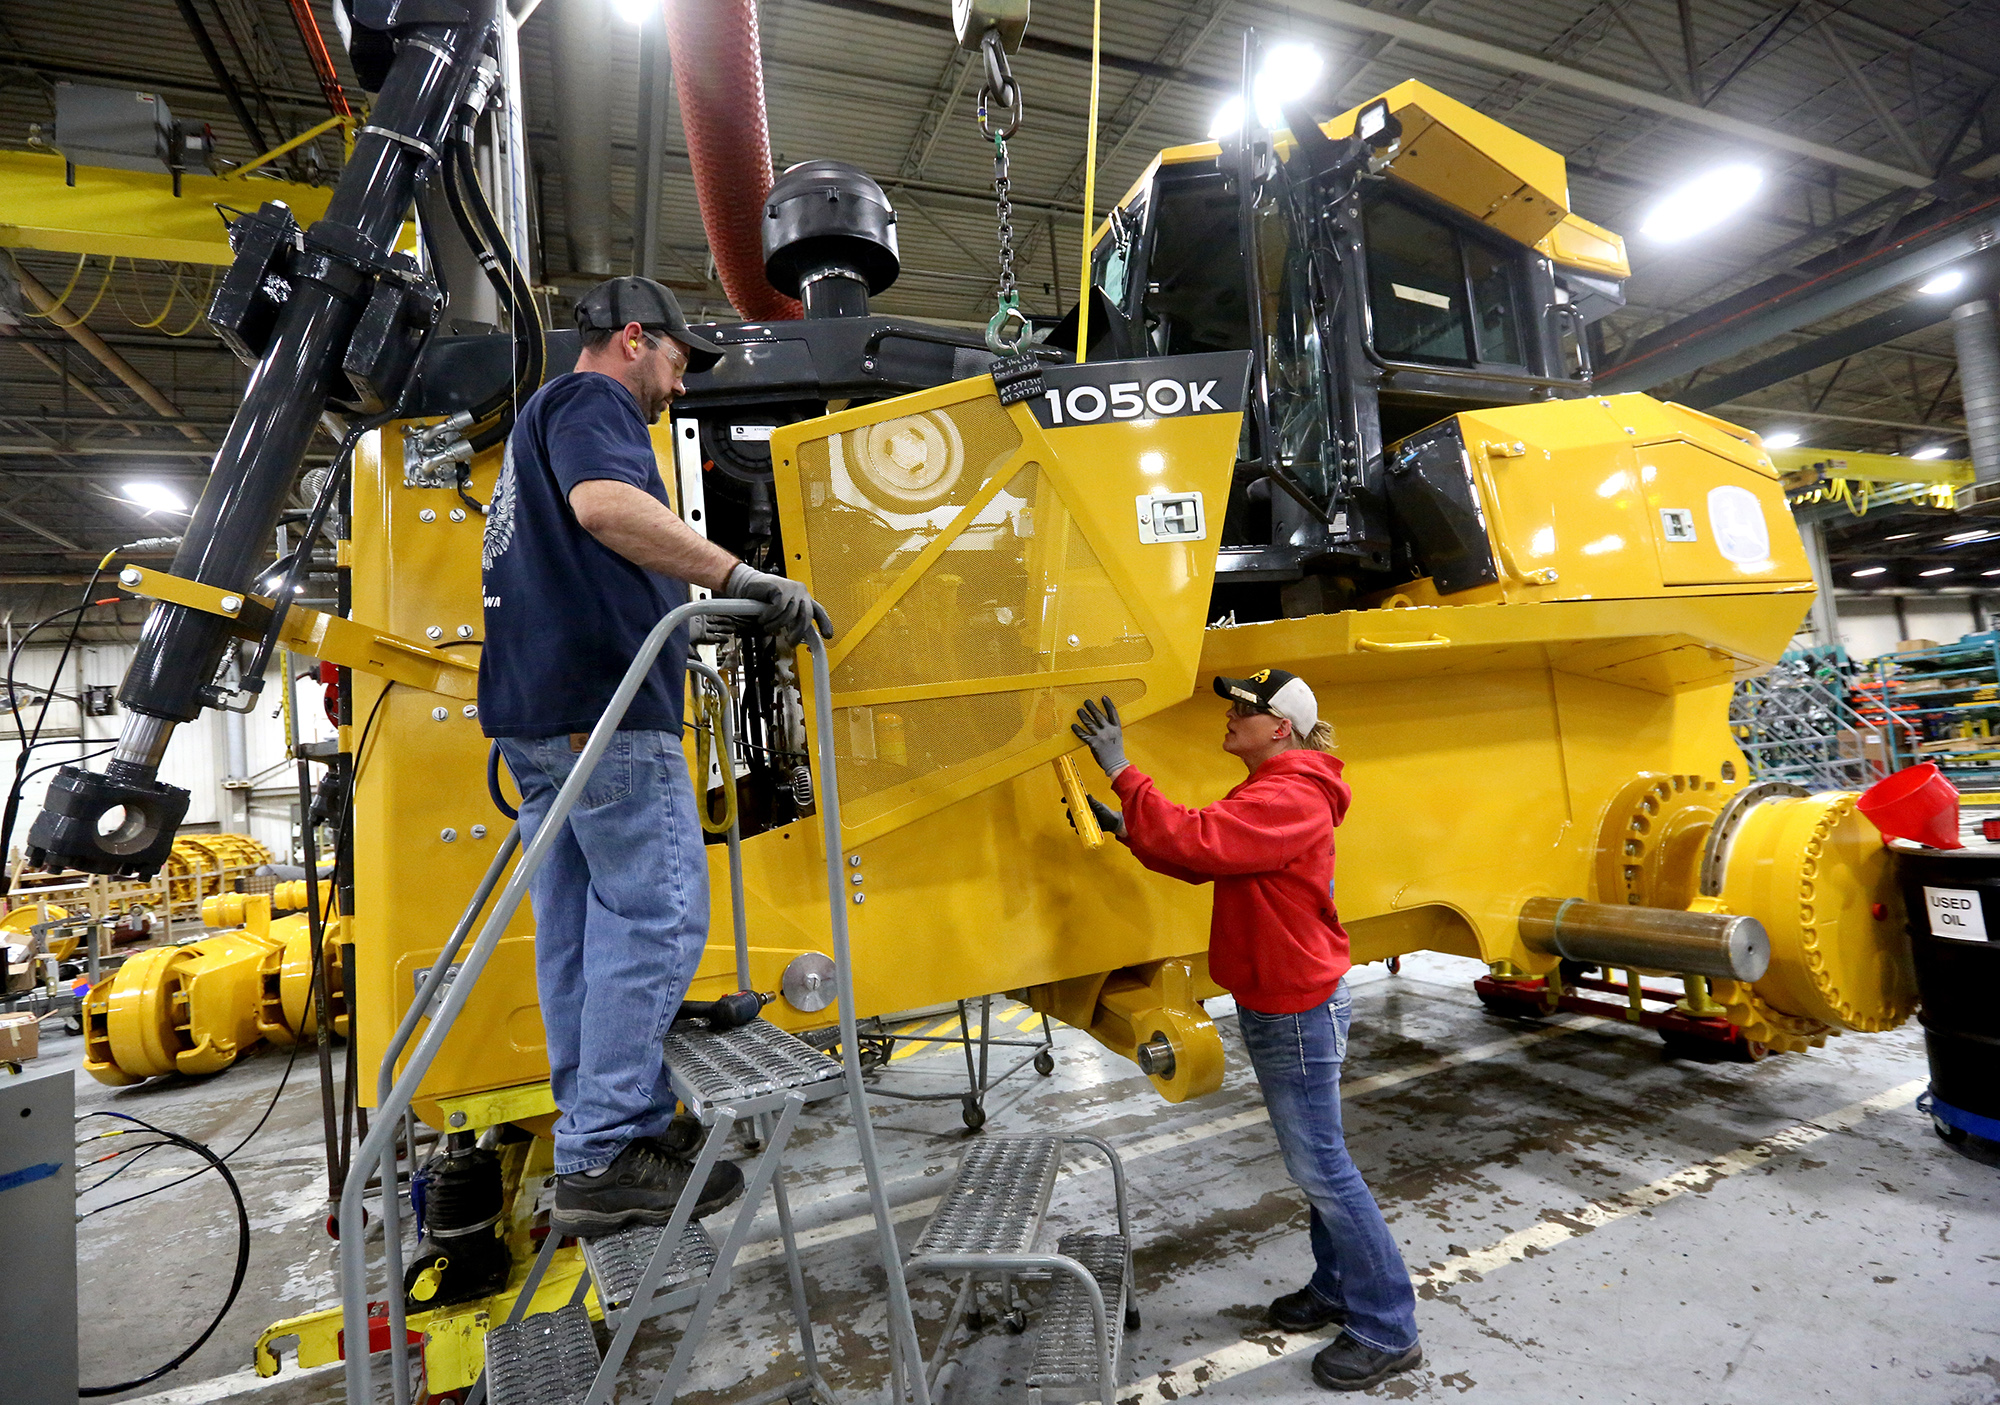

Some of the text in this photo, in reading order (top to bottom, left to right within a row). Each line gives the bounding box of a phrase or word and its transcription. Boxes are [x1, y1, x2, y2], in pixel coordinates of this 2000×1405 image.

[1045, 379, 1224, 424] 1050K
[1930, 895, 1972, 910] USED
[1941, 913, 1967, 927] OIL
